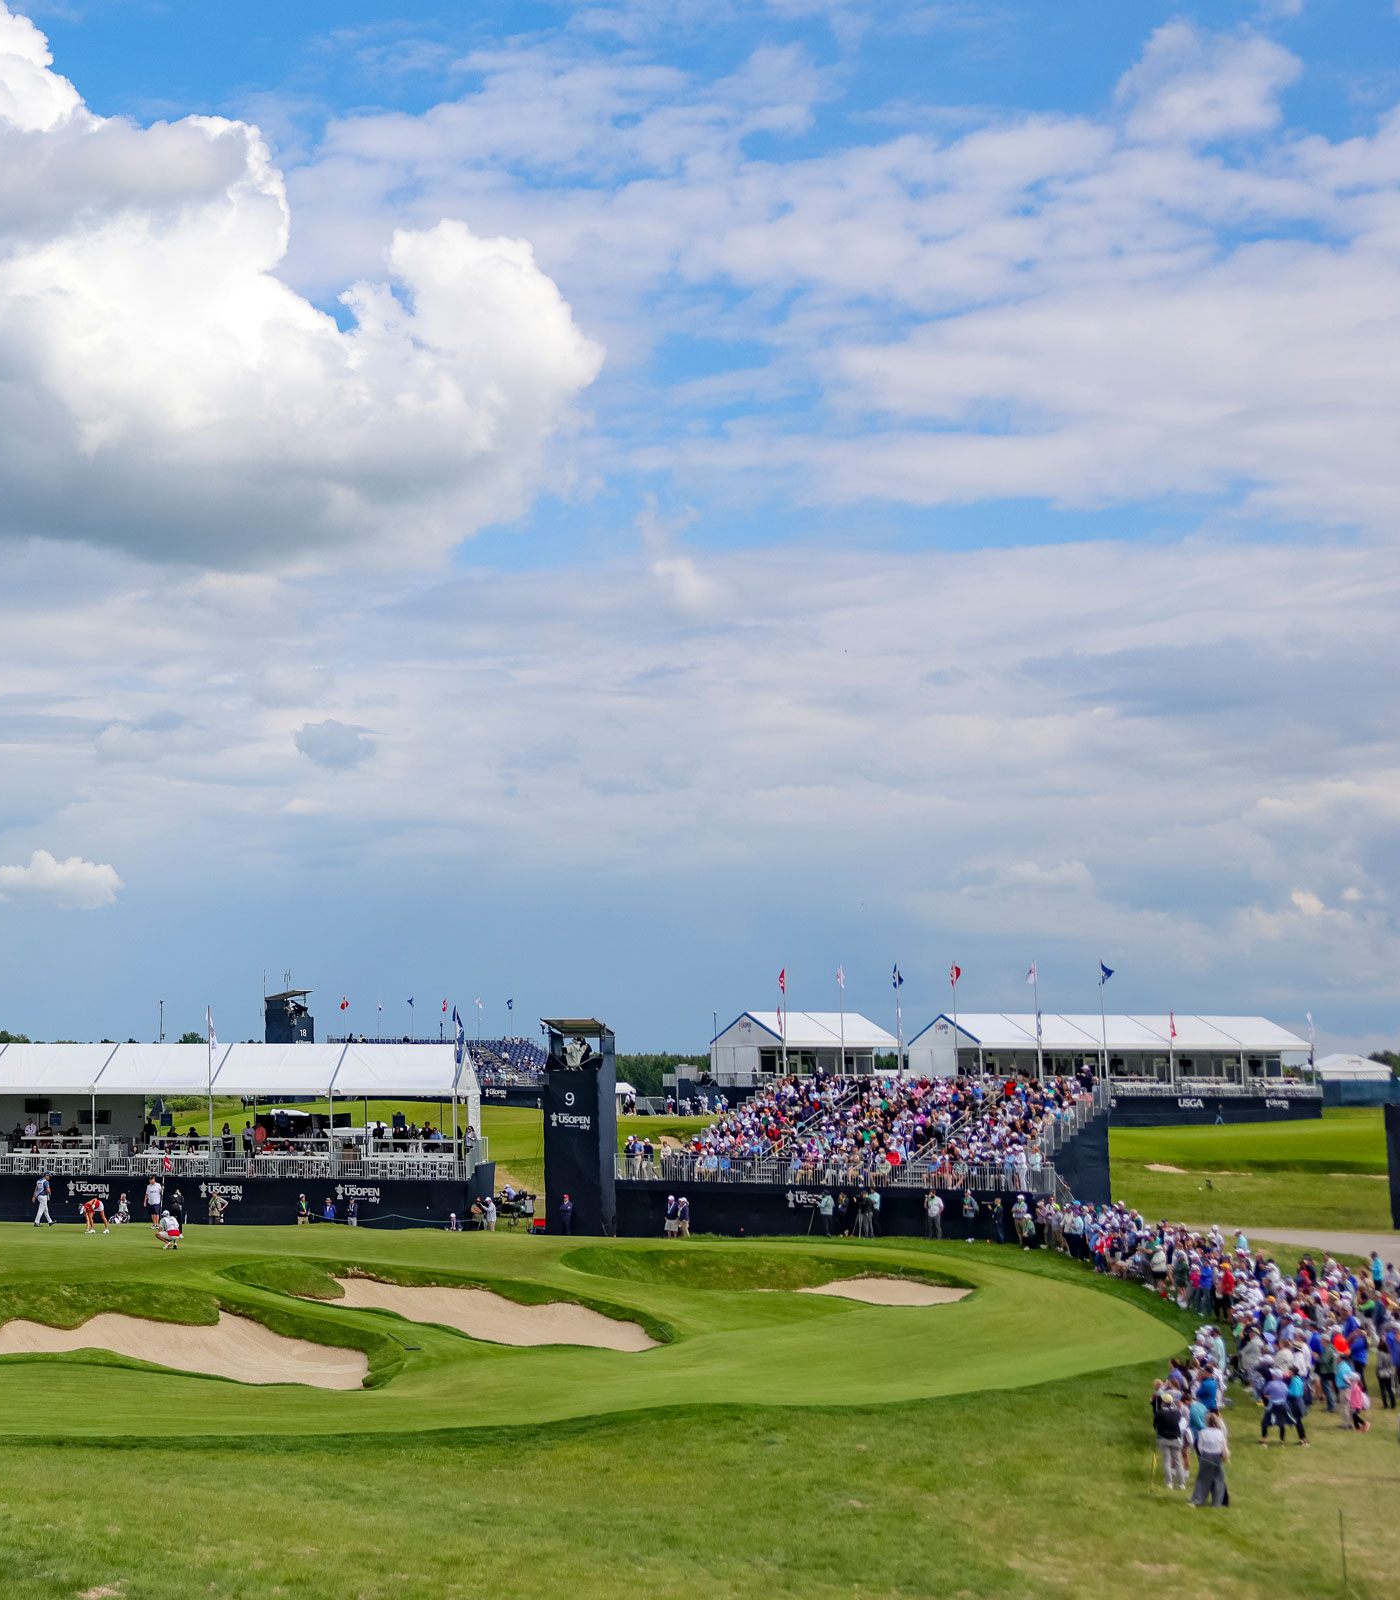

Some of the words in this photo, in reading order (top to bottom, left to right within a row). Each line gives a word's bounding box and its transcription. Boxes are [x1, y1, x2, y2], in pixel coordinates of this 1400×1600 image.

[299, 1029, 307, 1037] 18
[565, 1091, 575, 1106] 9
[1178, 1098, 1204, 1108] USGA
[75, 1183, 109, 1192] USOPEN
[208, 1185, 243, 1194] USOPEN
[344, 1187, 380, 1196] USOPEN
[231, 1194, 243, 1202] ally
[368, 1196, 380, 1205] ally
